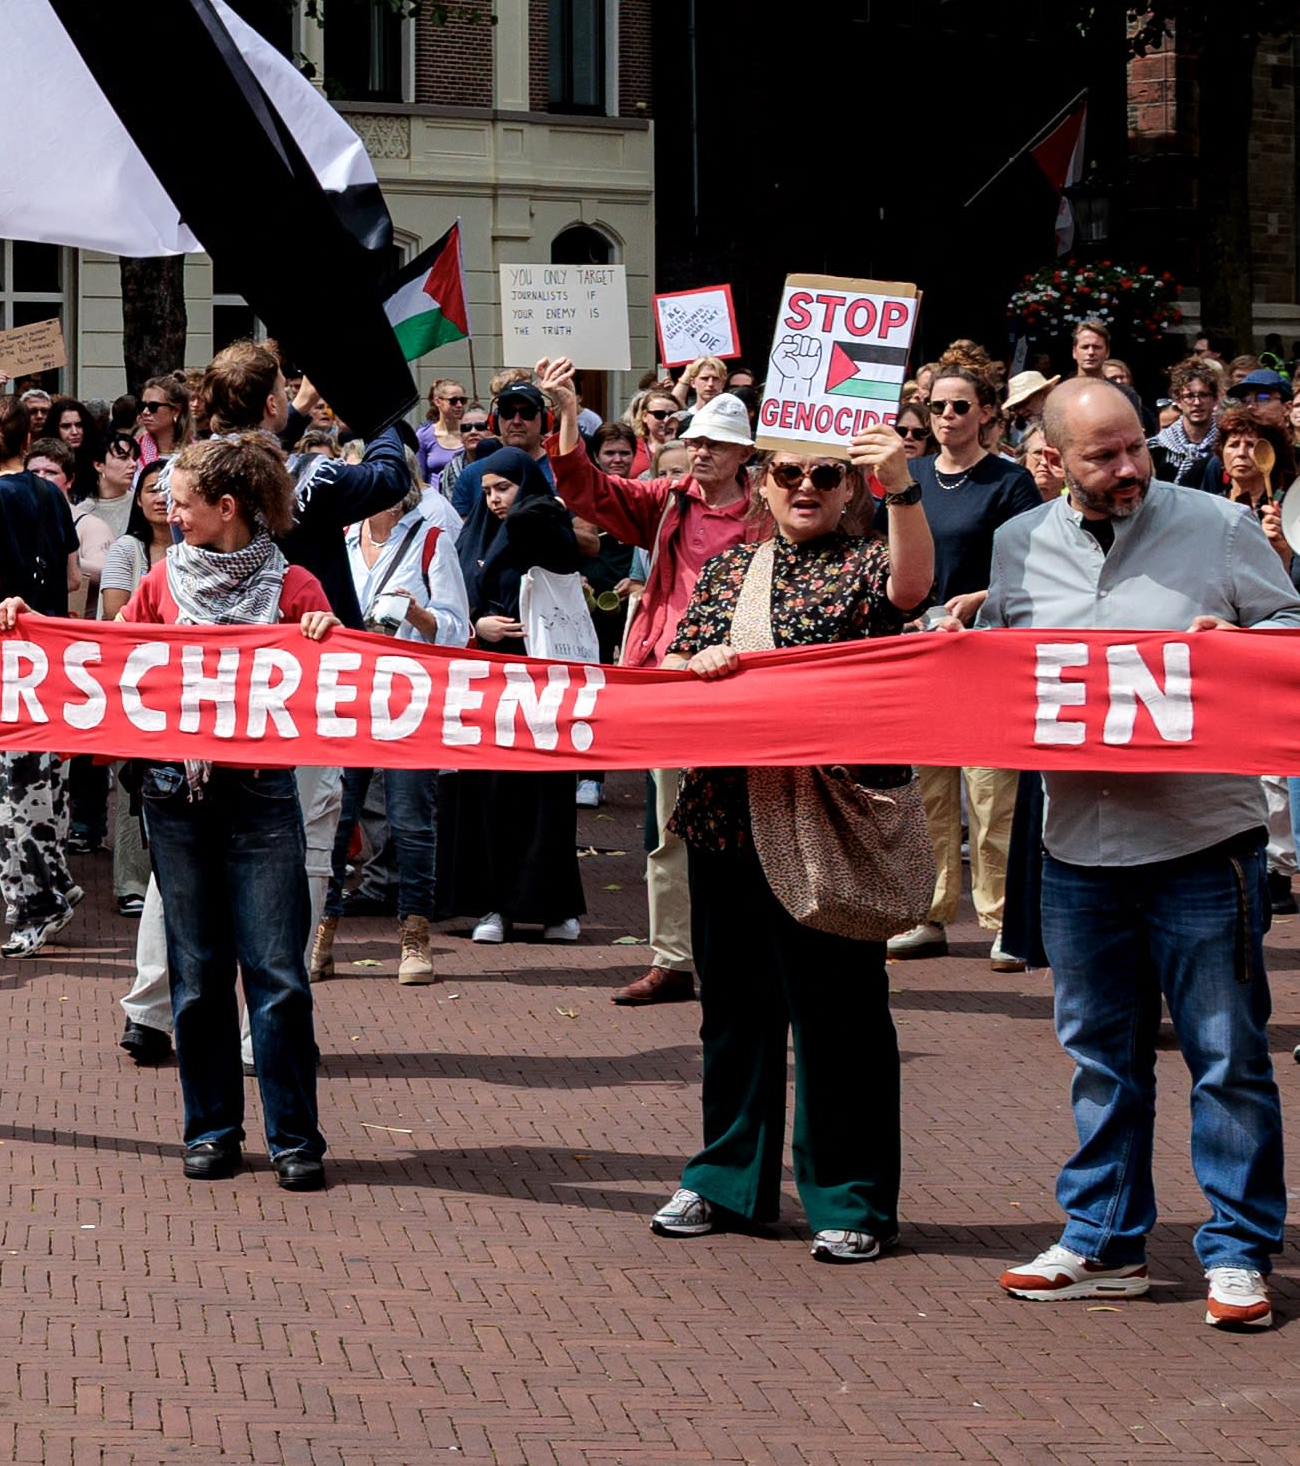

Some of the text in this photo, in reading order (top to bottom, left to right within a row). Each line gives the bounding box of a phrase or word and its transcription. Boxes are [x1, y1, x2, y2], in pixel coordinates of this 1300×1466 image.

[510, 269, 615, 286] YOU ONLY TARGET
[511, 291, 596, 301] JOURNALISTS IF
[512, 308, 600, 319] YOUR ENEMY IS
[783, 291, 909, 339] STOP
[514, 326, 572, 335] THE TRUTH
[699, 332, 721, 351] DIE
[1033, 642, 1195, 744] EN
